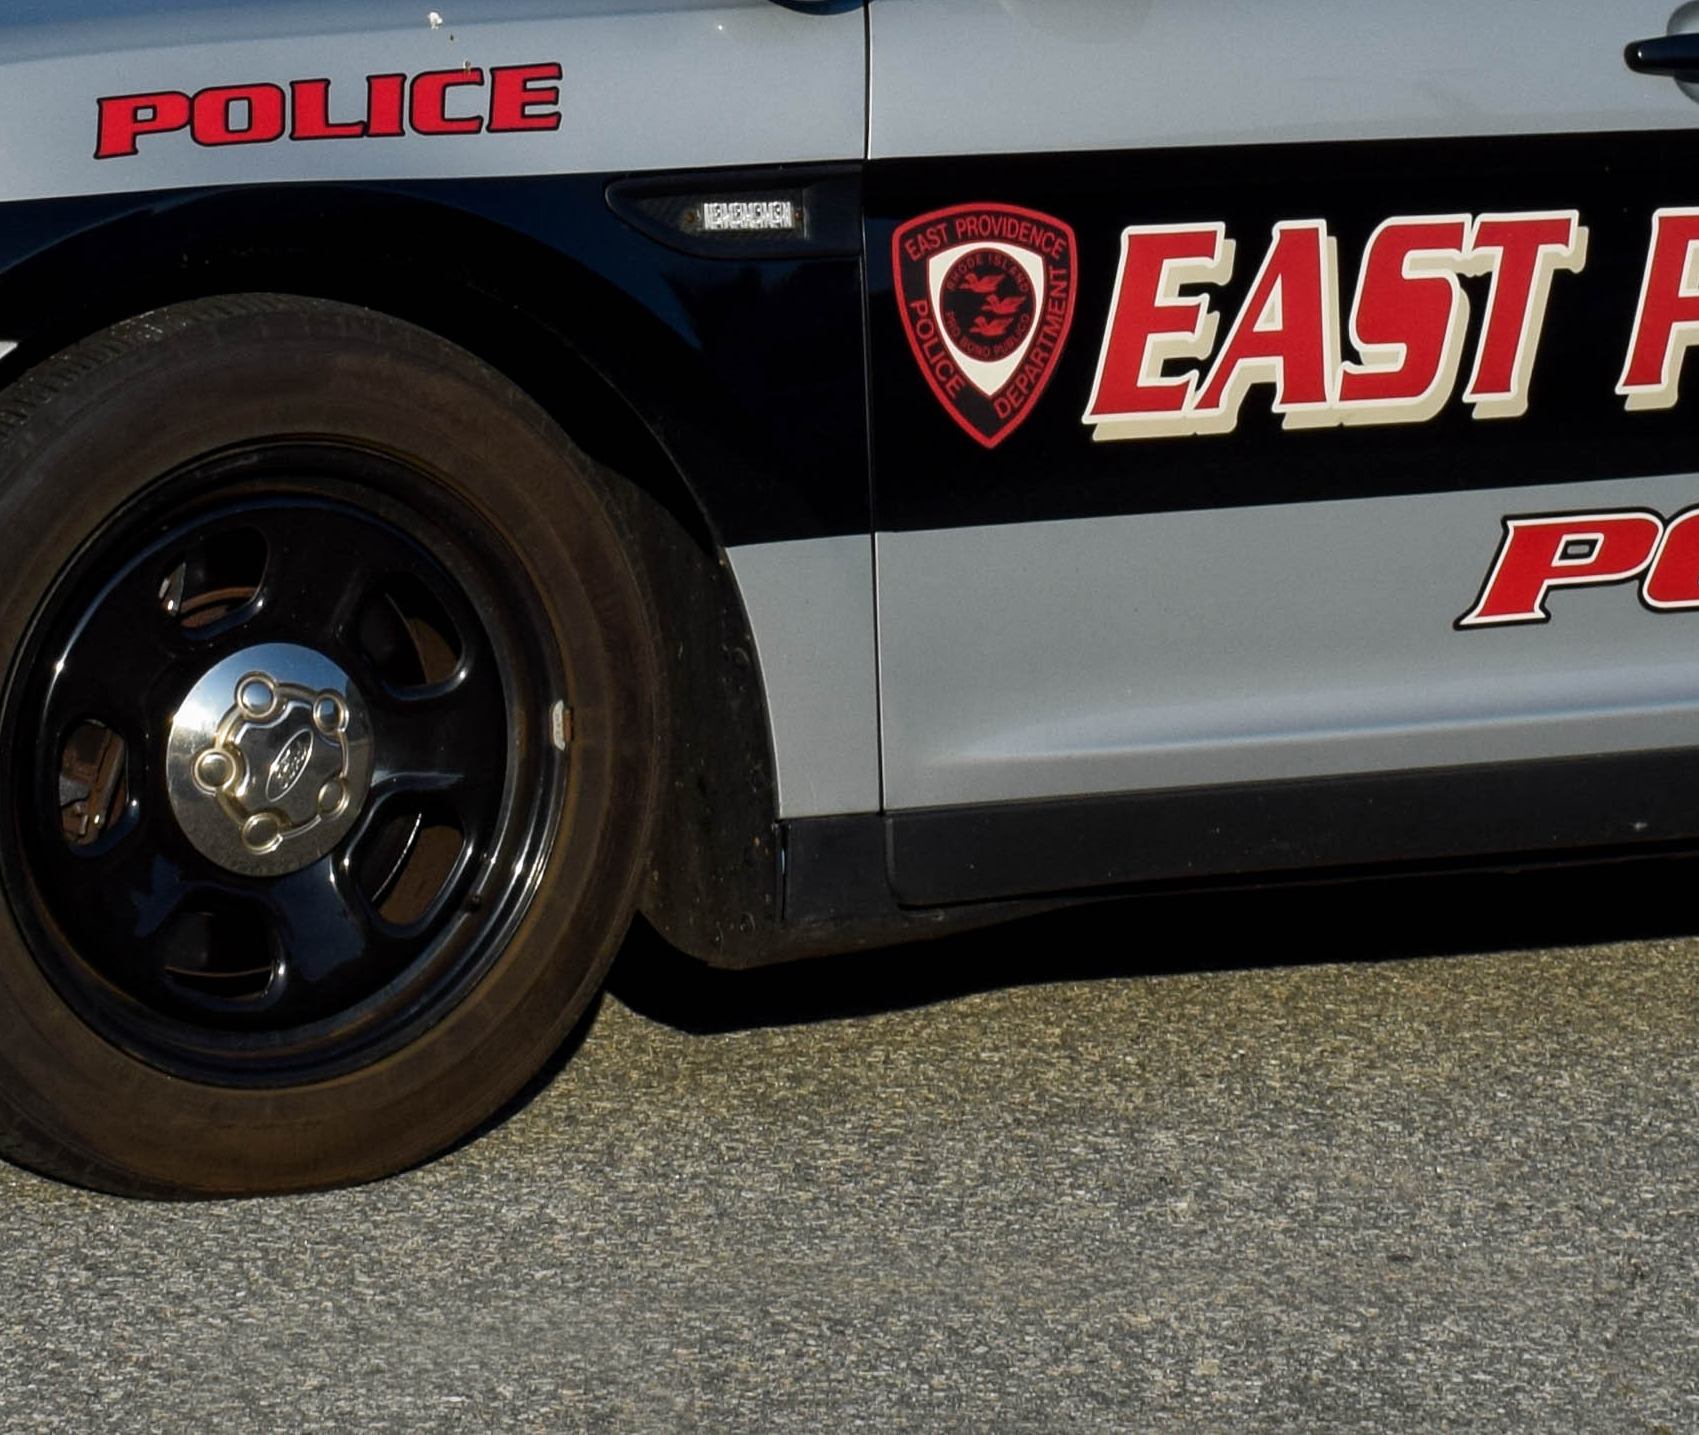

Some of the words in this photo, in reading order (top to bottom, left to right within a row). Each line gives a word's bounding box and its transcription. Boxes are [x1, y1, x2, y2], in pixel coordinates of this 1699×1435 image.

[94, 62, 562, 159] POLICE
[904, 222, 951, 262] EAST
[954, 214, 1067, 260] PROVIDENCE
[909, 298, 966, 398] POLICE
[993, 265, 1069, 419] DEPARTMENT
[1081, 209, 1590, 442] EAST
